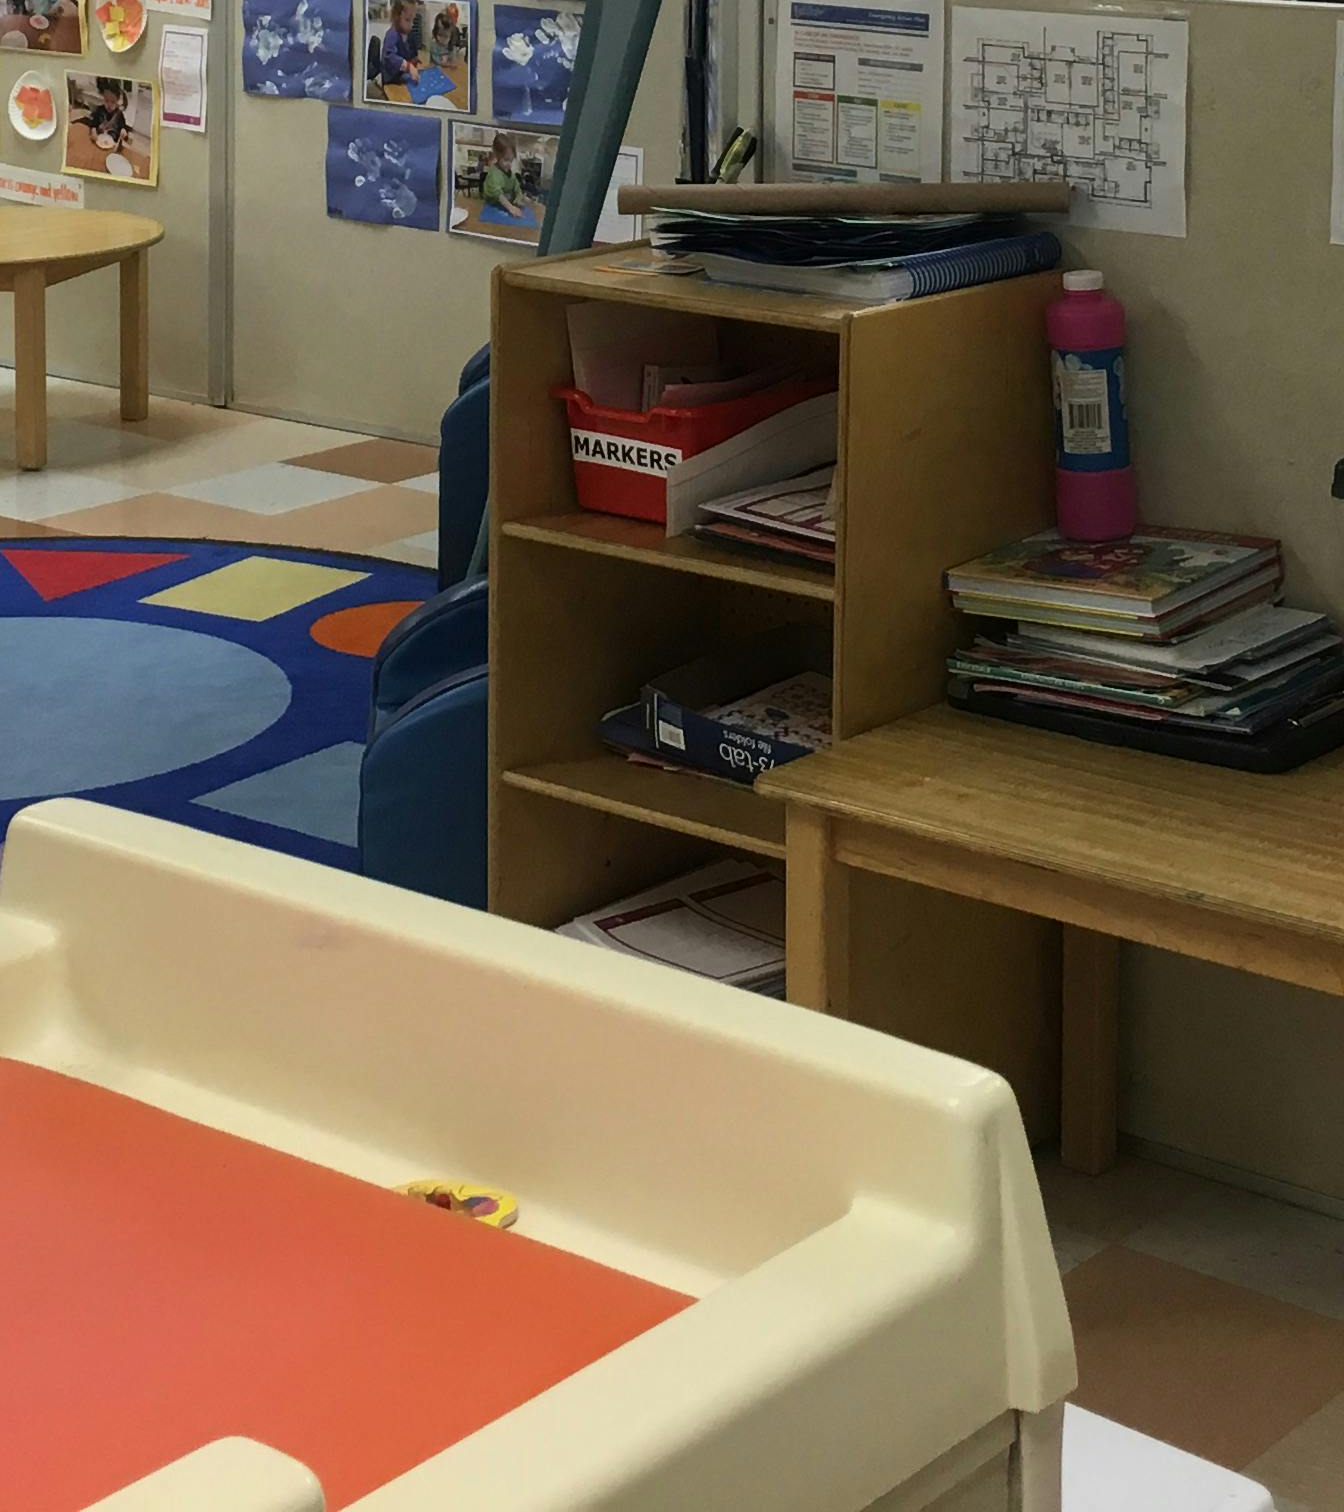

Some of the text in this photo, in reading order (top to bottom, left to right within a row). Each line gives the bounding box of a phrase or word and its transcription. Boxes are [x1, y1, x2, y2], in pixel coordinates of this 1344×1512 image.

[574, 435, 677, 471] MARKERS
[722, 729, 772, 755] file folders
